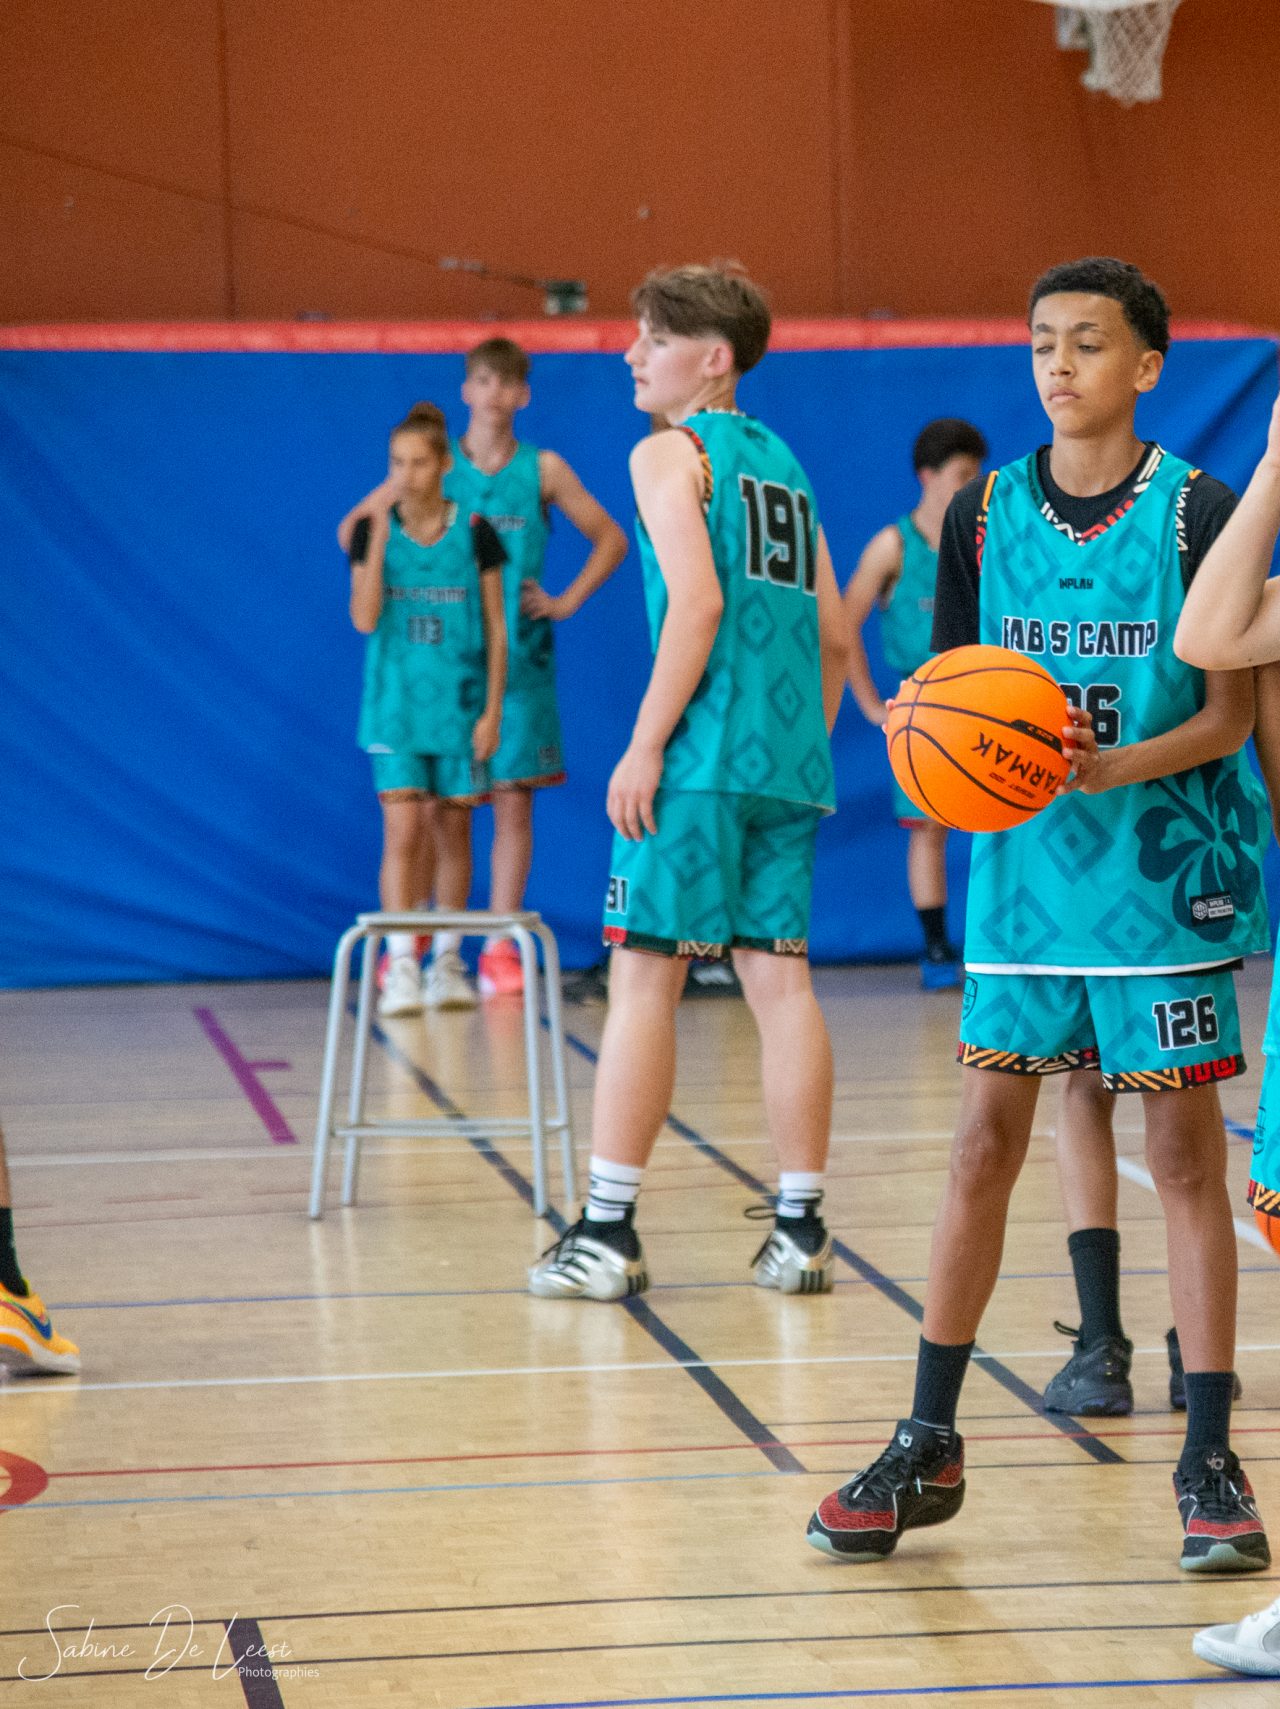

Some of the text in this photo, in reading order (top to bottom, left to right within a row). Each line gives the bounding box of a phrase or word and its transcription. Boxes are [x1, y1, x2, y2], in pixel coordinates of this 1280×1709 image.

[738, 473, 817, 596] 191
[1049, 620, 1071, 656] S
[1077, 620, 1158, 657] CAMP
[1152, 993, 1219, 1051] 126
